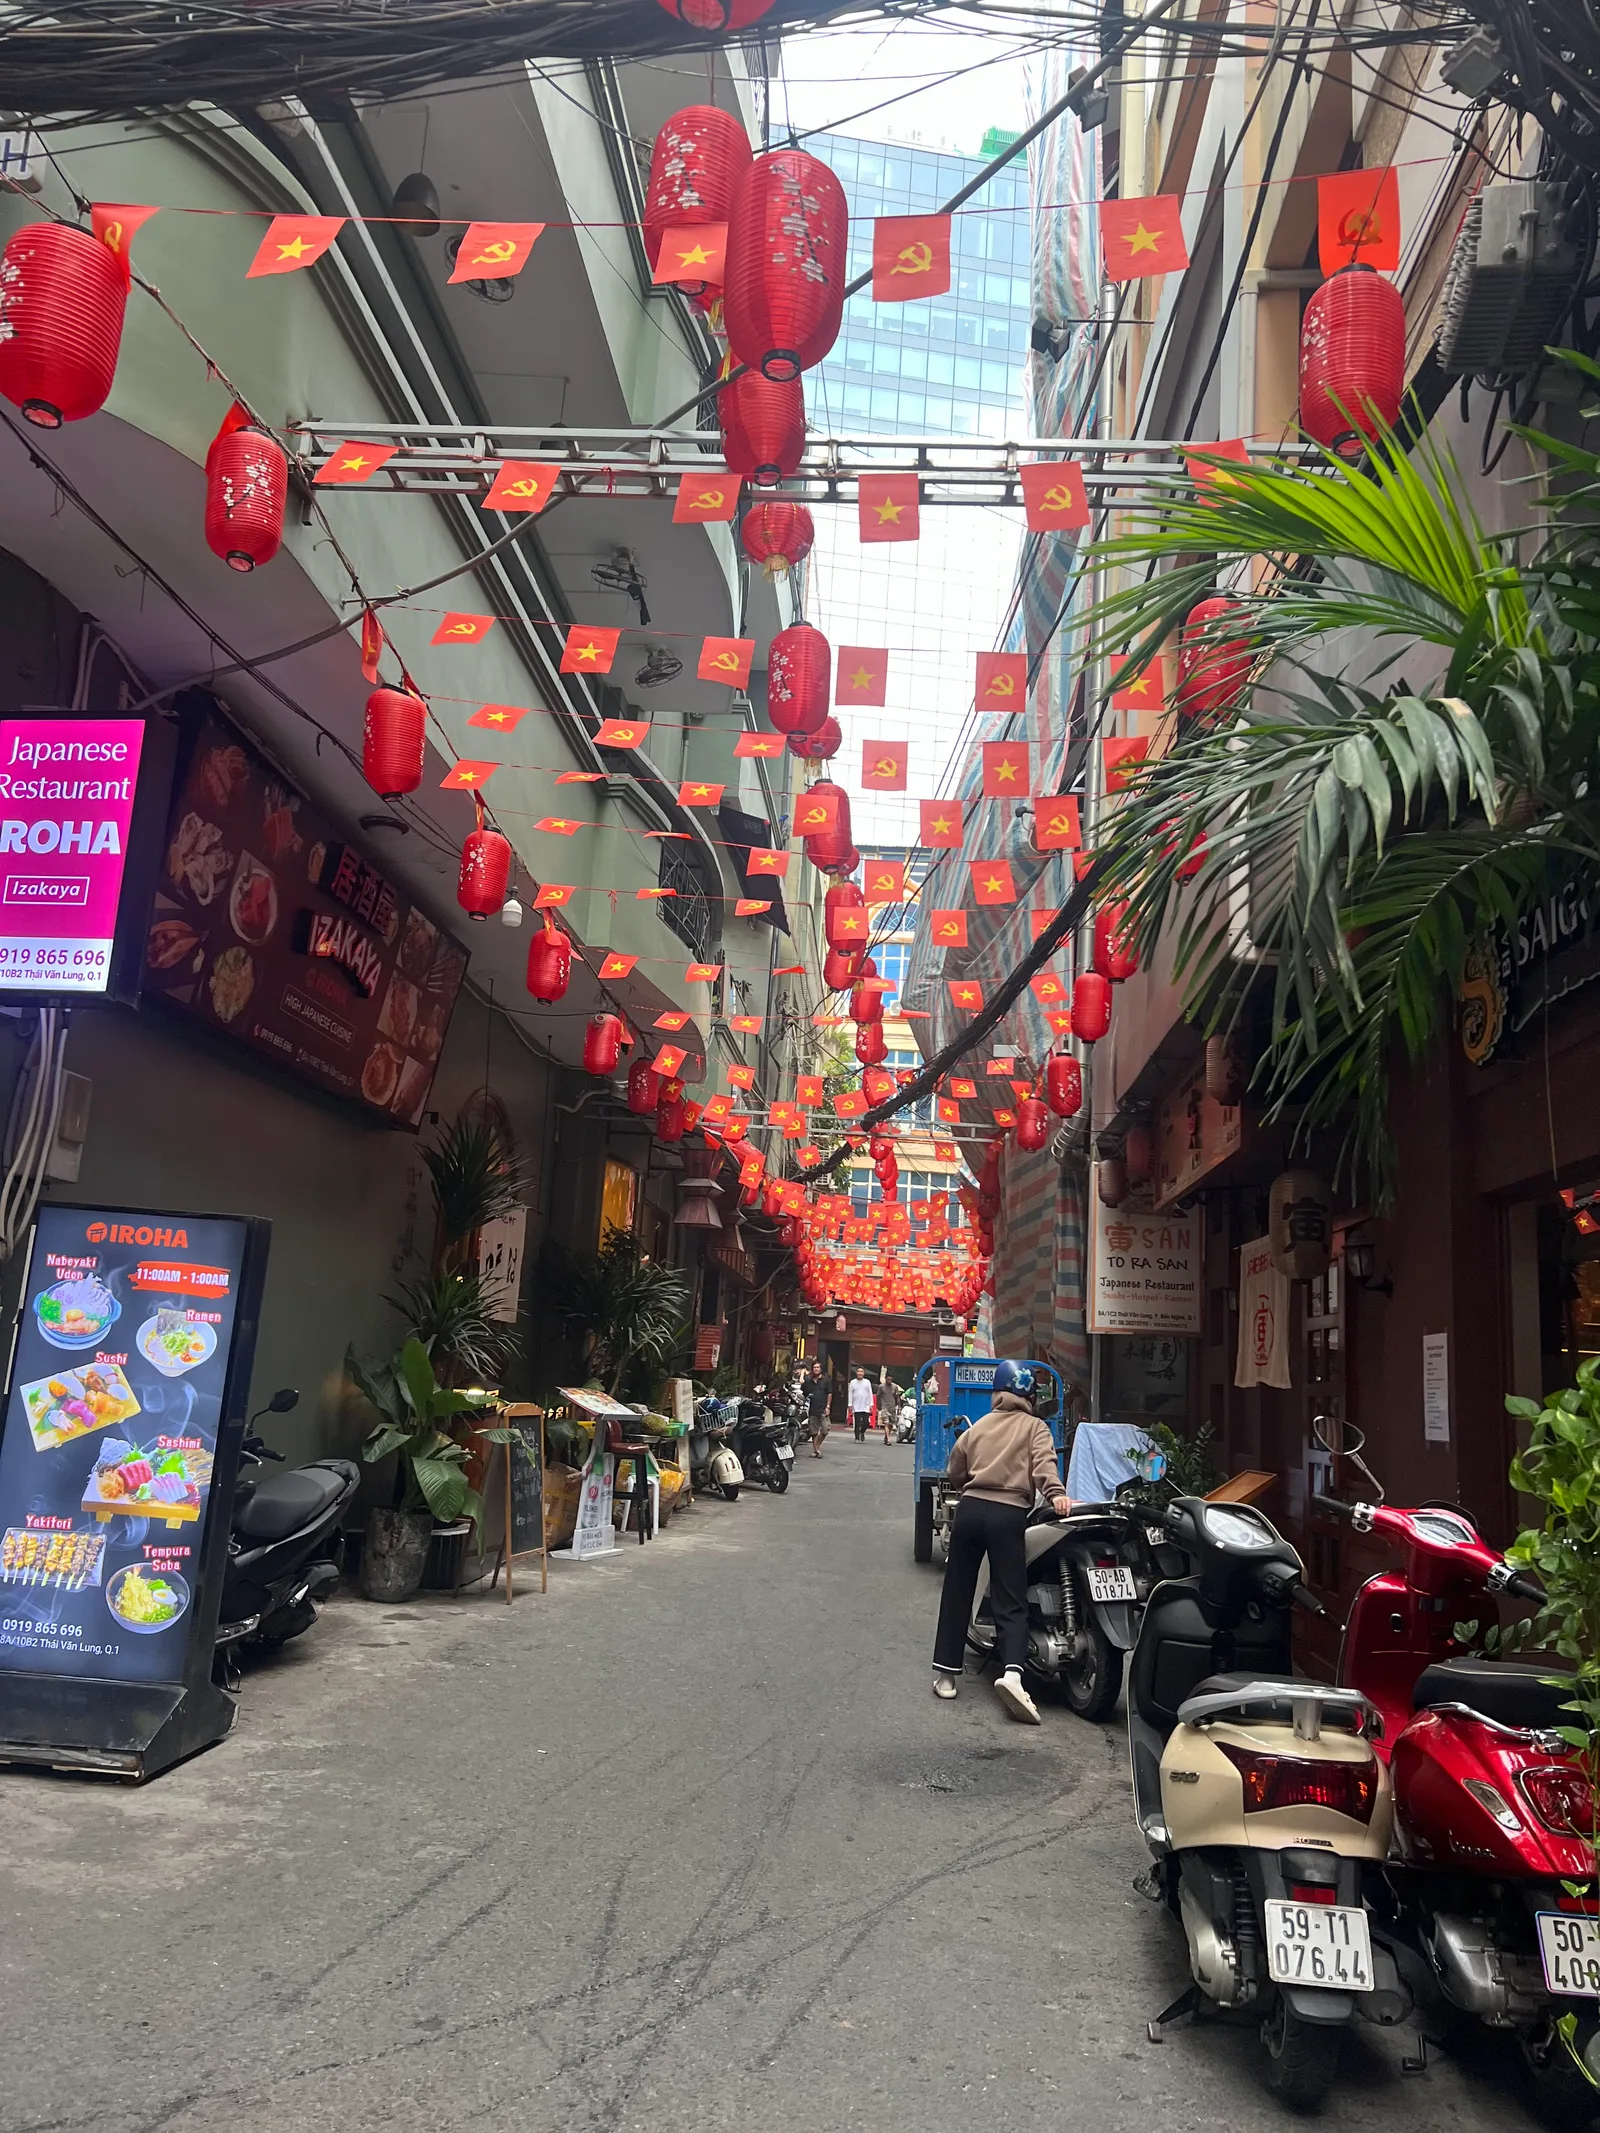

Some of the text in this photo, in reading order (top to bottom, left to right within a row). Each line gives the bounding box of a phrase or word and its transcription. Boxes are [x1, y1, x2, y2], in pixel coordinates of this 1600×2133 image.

[8, 736, 128, 769] Japanese
[0, 774, 131, 800] Restaurant
[12, 881, 81, 898] Izakaya
[36, 949, 68, 965] 865
[73, 950, 105, 966] 696
[309, 915, 382, 998] IZAKAYA
[24, 969, 43, 979] Thái
[45, 970, 61, 979] Văn
[62, 971, 86, 981] Lung,
[285, 993, 353, 1043] HIGH JAPANESE CUISINE
[109, 1224, 188, 1248] IROHA
[1104, 1221, 1191, 1253] 寅 SAN
[46, 1253, 97, 1268] Nabeyaki
[1107, 1257, 1188, 1271] TO RA SAN
[56, 1268, 84, 1281] Udon
[136, 1268, 181, 1283] 11:00AM
[190, 1272, 229, 1287] 1:00AM
[1100, 1277, 1195, 1292] Japanese Restaurant
[186, 1309, 222, 1323] Ramen
[96, 1351, 128, 1365] Sushi
[978, 1370, 994, 1381] 0938
[157, 1436, 201, 1450] Sashimi
[26, 1514, 73, 1530] Yakitori
[143, 1544, 191, 1558] Tempura
[152, 1560, 181, 1571] Soba
[1095, 1570, 1126, 1583] 50-AB
[1096, 1584, 1132, 1599] 018.74
[2, 1618, 83, 1637] 0919 865 696
[40, 1638, 59, 1649] Thái
[60, 1640, 77, 1651] Văn
[79, 1642, 103, 1655] Lung,
[1281, 1908, 1350, 1945] 59-T1
[1553, 1920, 1600, 1953] 50-
[1275, 1943, 1367, 1983] 076.44
